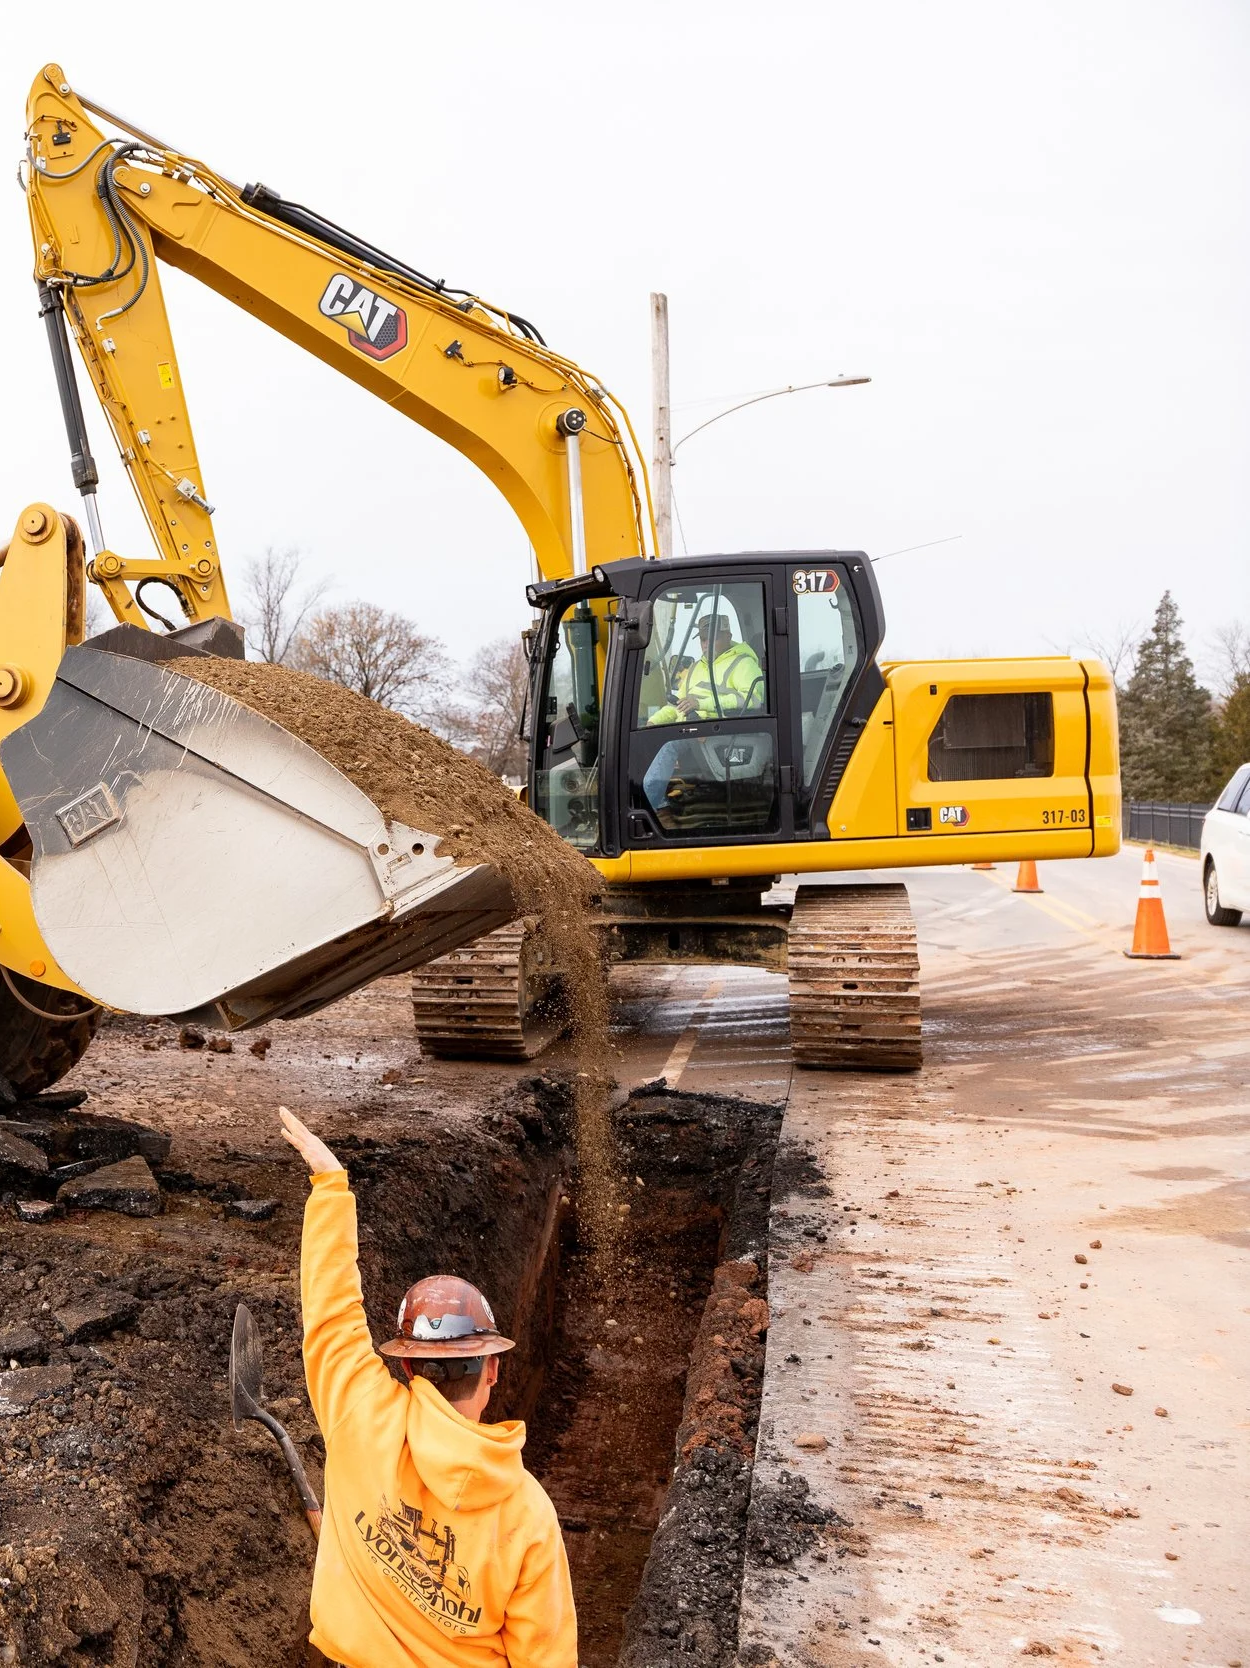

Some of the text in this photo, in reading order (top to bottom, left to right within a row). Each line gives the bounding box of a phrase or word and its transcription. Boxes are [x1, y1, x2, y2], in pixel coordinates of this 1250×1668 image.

[319, 273, 398, 343] CAT
[794, 571, 828, 592] 317
[61, 789, 113, 838] CAT
[939, 806, 963, 823] CAT
[1042, 809, 1085, 824] 317-03
[382, 1568, 467, 1635] contractors
